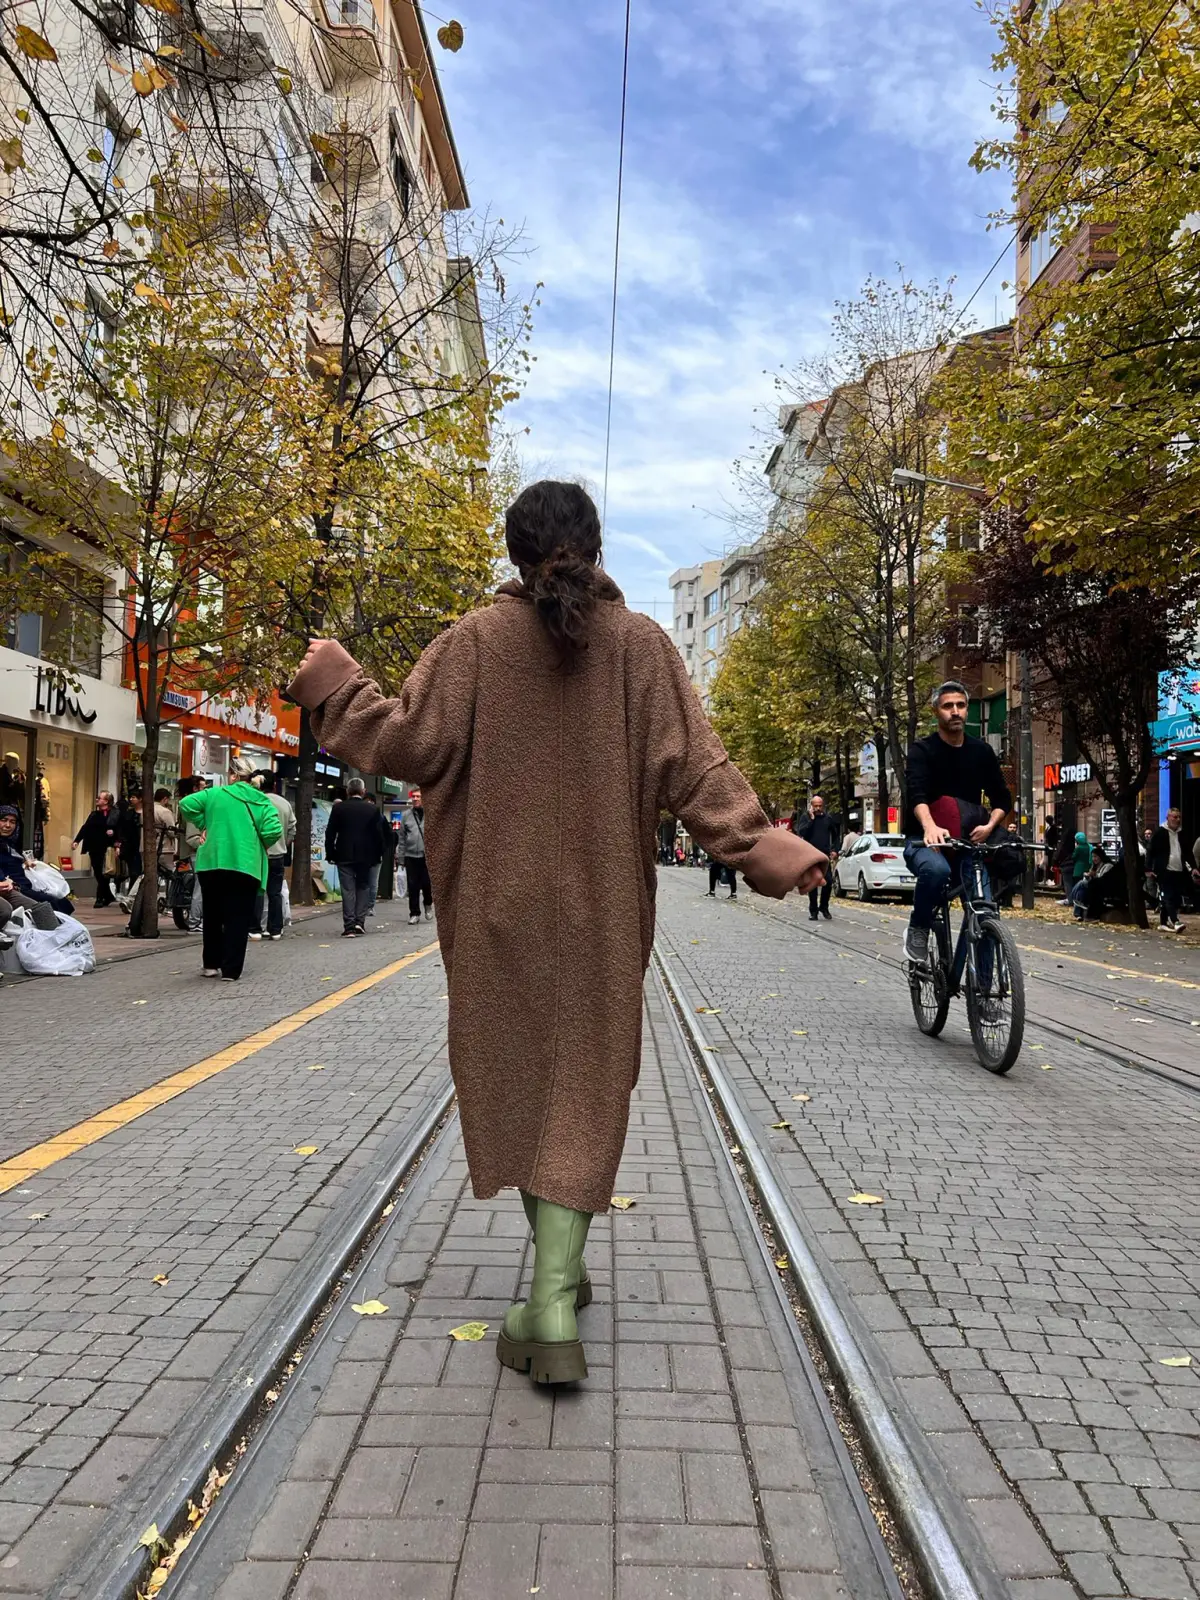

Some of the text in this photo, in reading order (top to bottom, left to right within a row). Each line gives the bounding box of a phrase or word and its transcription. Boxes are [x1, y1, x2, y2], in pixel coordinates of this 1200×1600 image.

[163, 692, 189, 709] SAMSUNG
[47, 741, 70, 759] LTB
[1060, 763, 1091, 783] STREET
